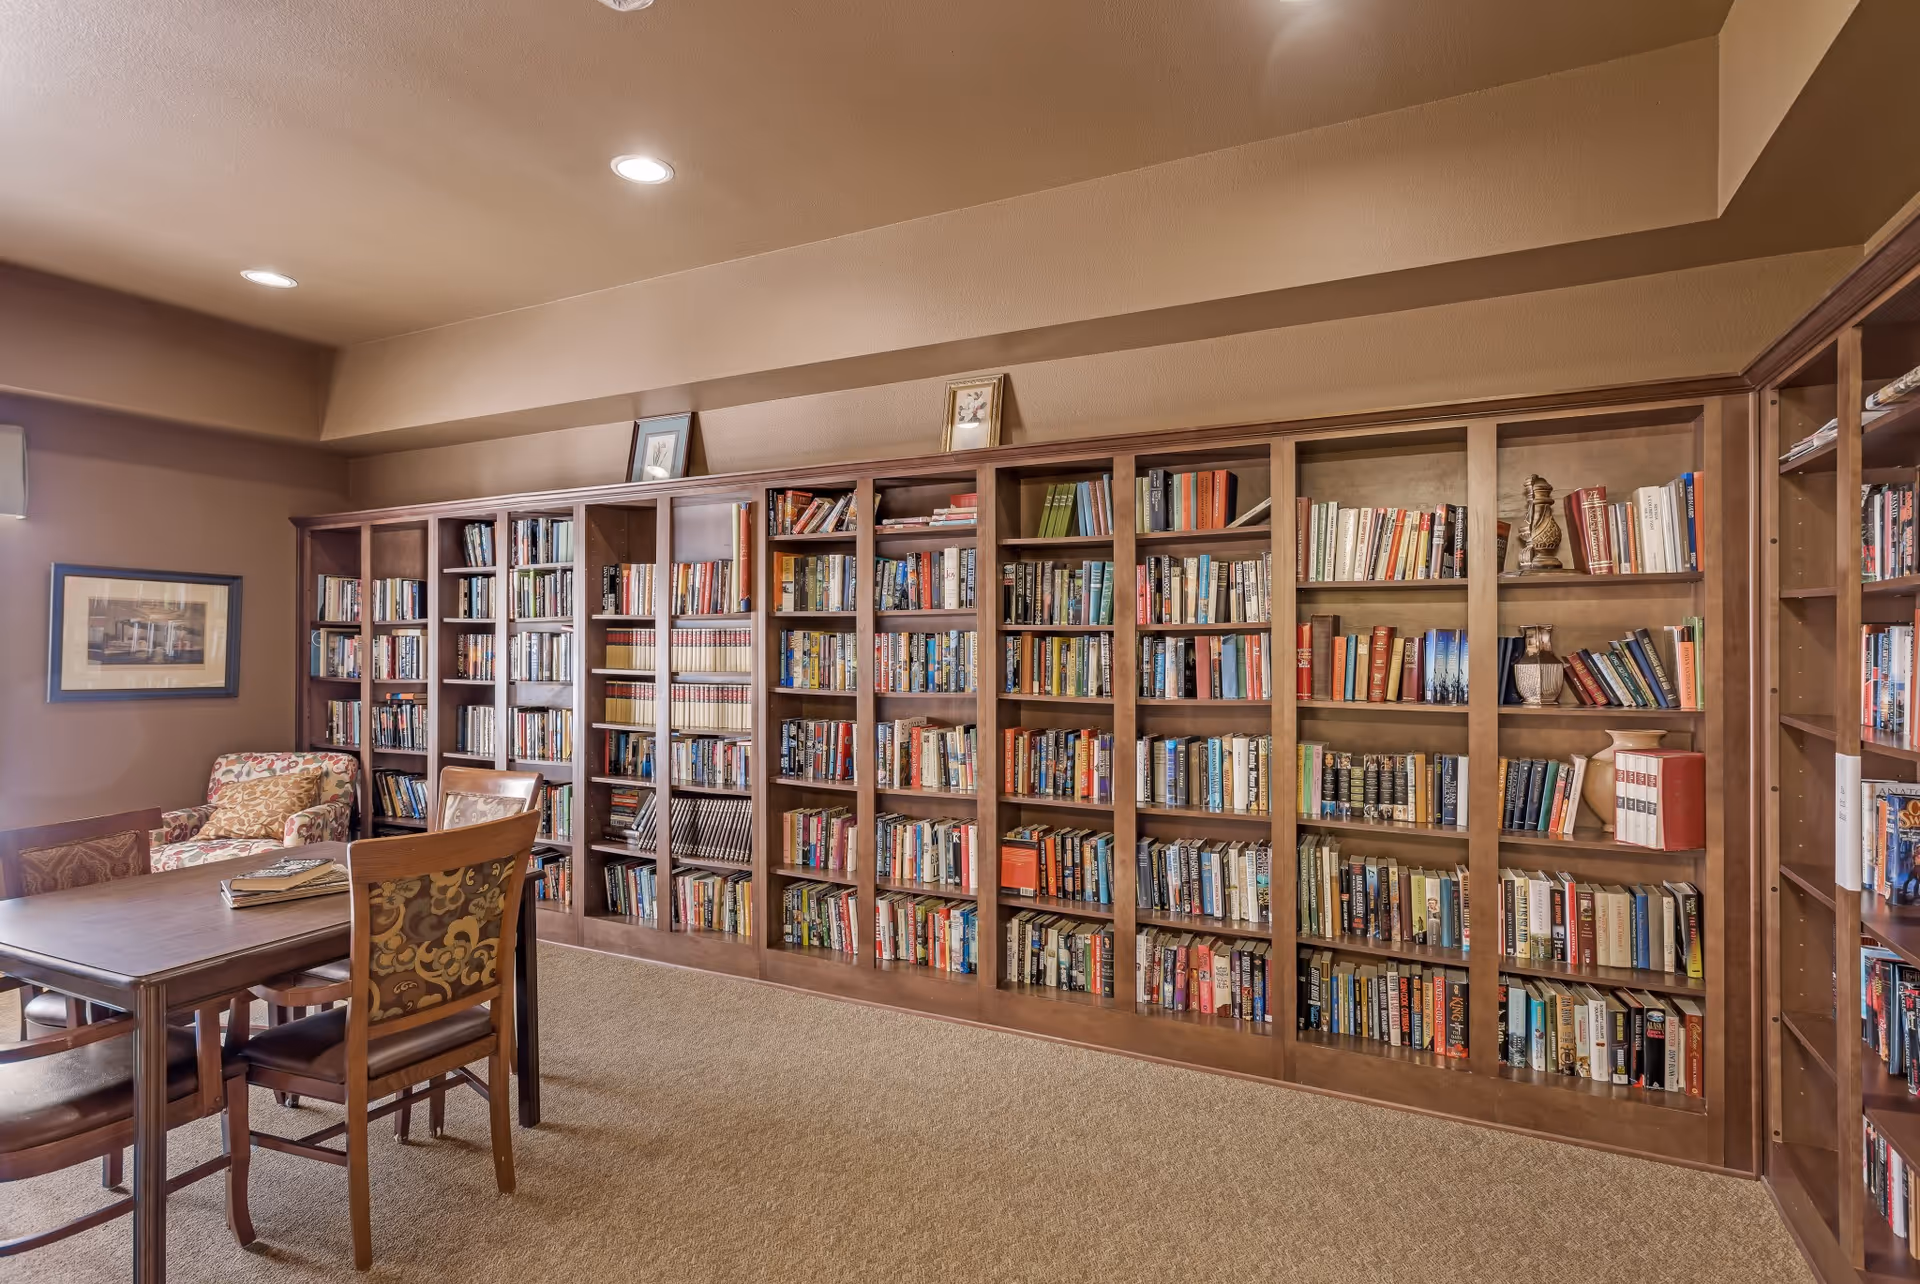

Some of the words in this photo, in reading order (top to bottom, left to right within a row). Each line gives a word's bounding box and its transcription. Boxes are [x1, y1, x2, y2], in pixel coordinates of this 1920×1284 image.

[1248, 751, 1257, 769] Family
[1516, 897, 1528, 917] ELLIS
[1517, 918, 1528, 943] ISLAND
[1449, 997, 1464, 1021] KING
